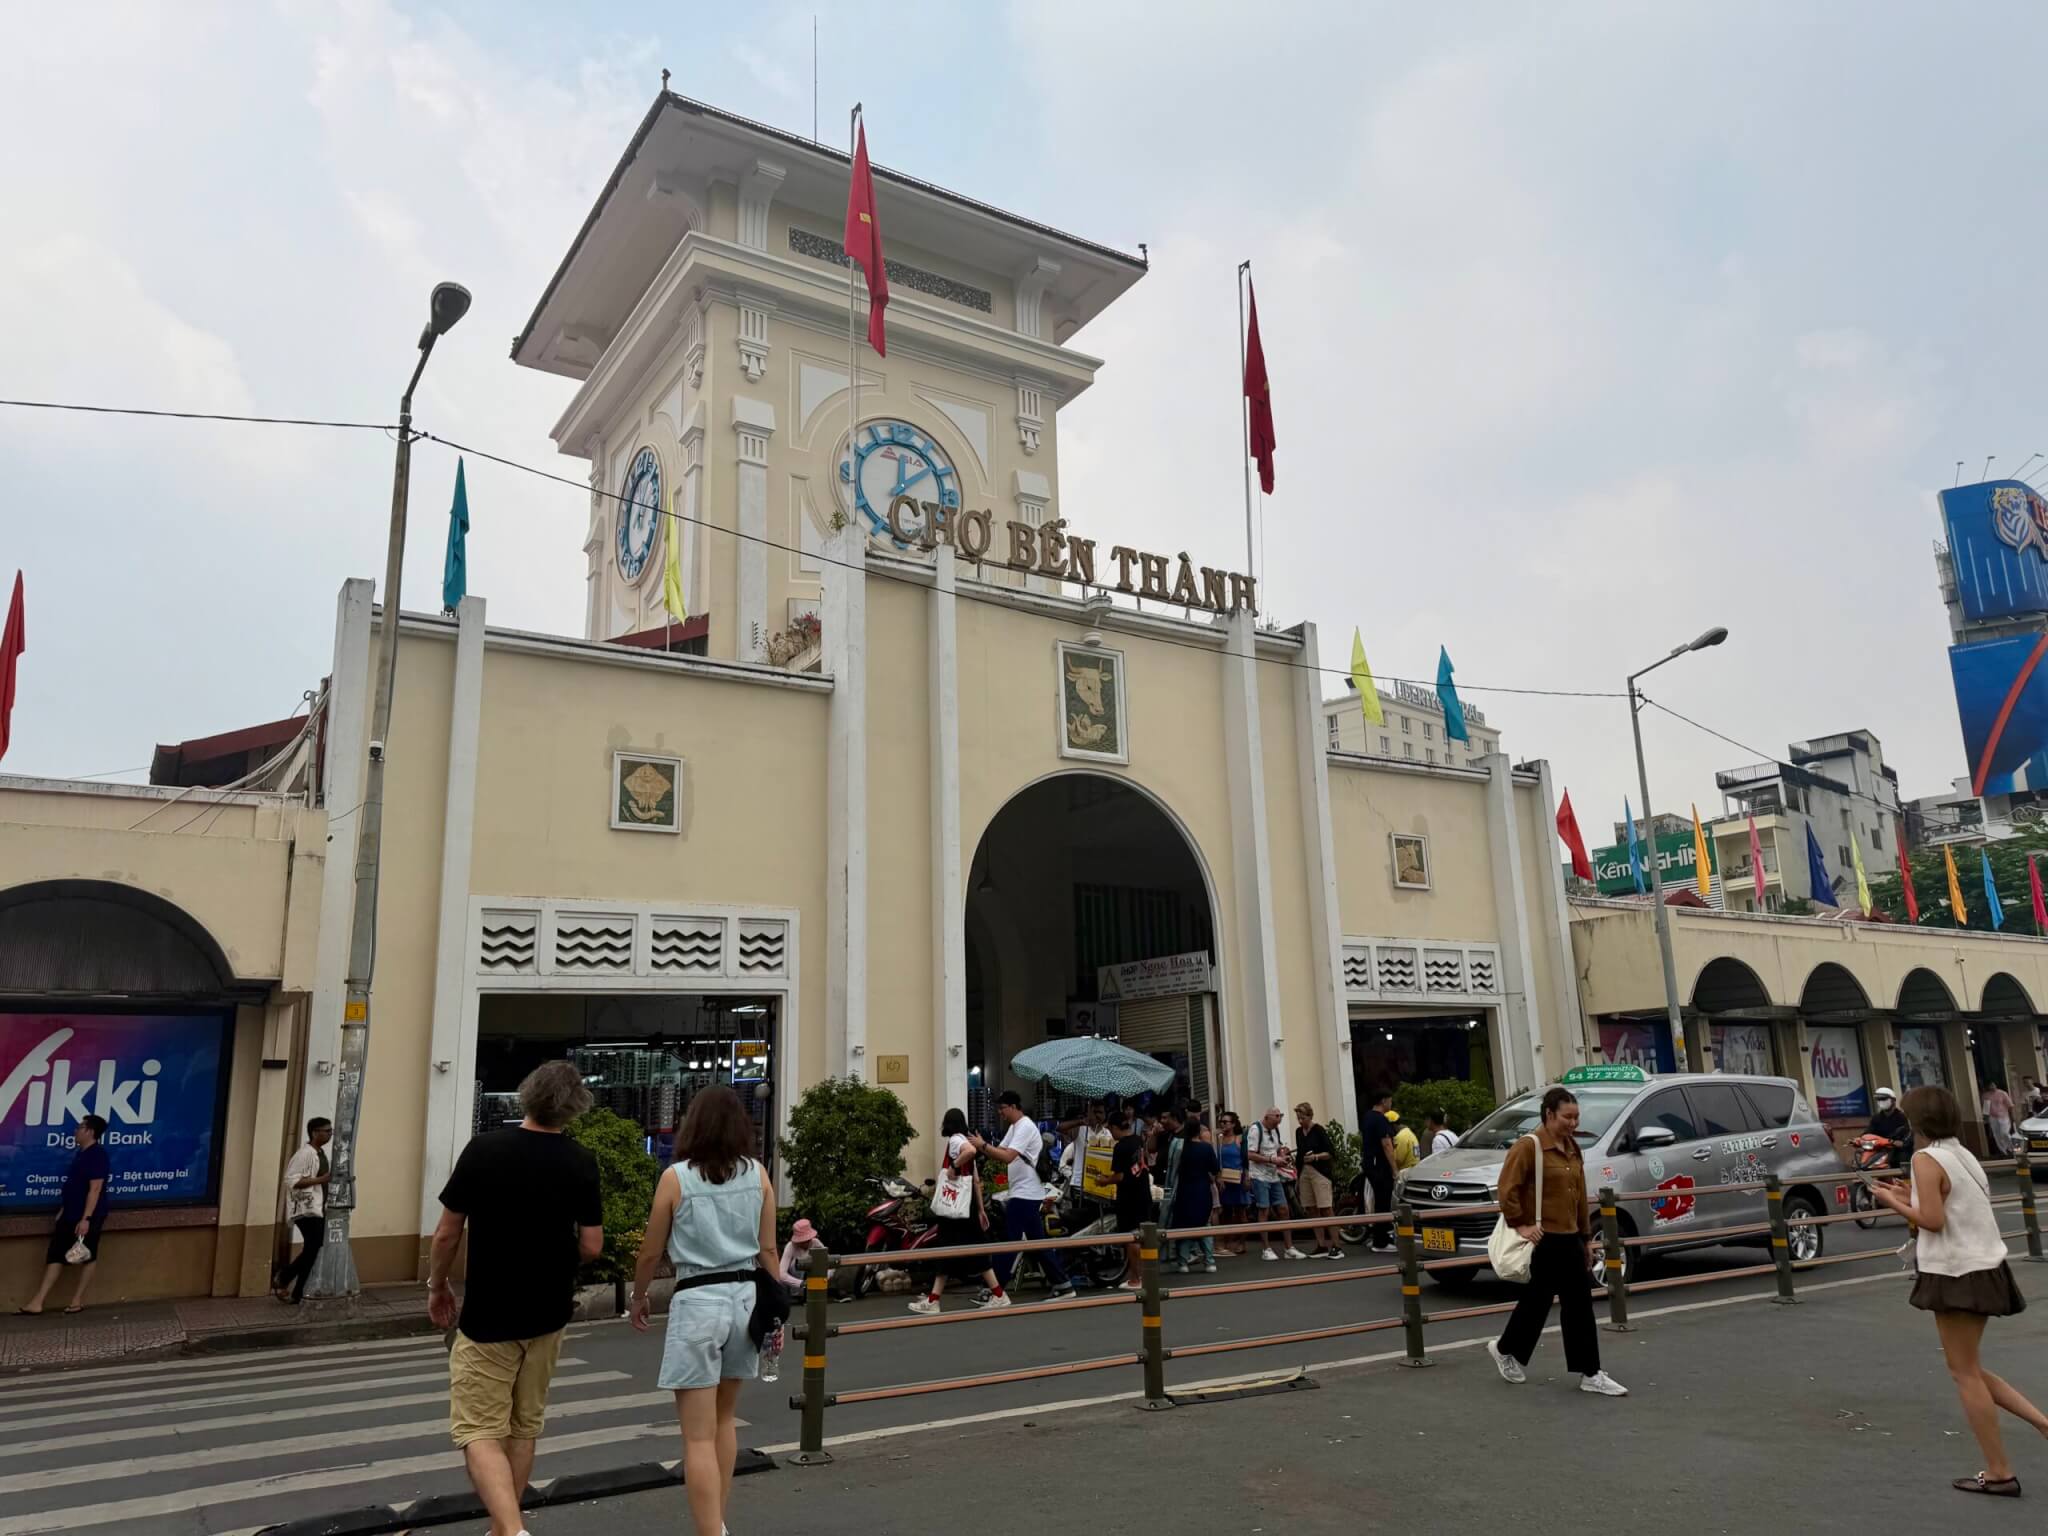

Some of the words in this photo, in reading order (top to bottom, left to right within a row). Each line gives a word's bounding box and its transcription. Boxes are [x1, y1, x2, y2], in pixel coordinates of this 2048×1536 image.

[888, 495, 992, 565] CHỢ
[1007, 518, 1096, 582] BẾN
[1111, 545, 1257, 617] THÀNH
[1587, 1072, 1600, 1080] 27
[1623, 1071, 1638, 1079] 27
[47, 1133, 104, 1149] Digl
[109, 1131, 152, 1145] Bank
[26, 1173, 59, 1185] Chạm
[123, 1171, 142, 1182] Bật
[176, 1168, 189, 1178] lai
[25, 1187, 39, 1196] Be
[116, 1185, 137, 1194] your
[139, 1182, 169, 1192] future
